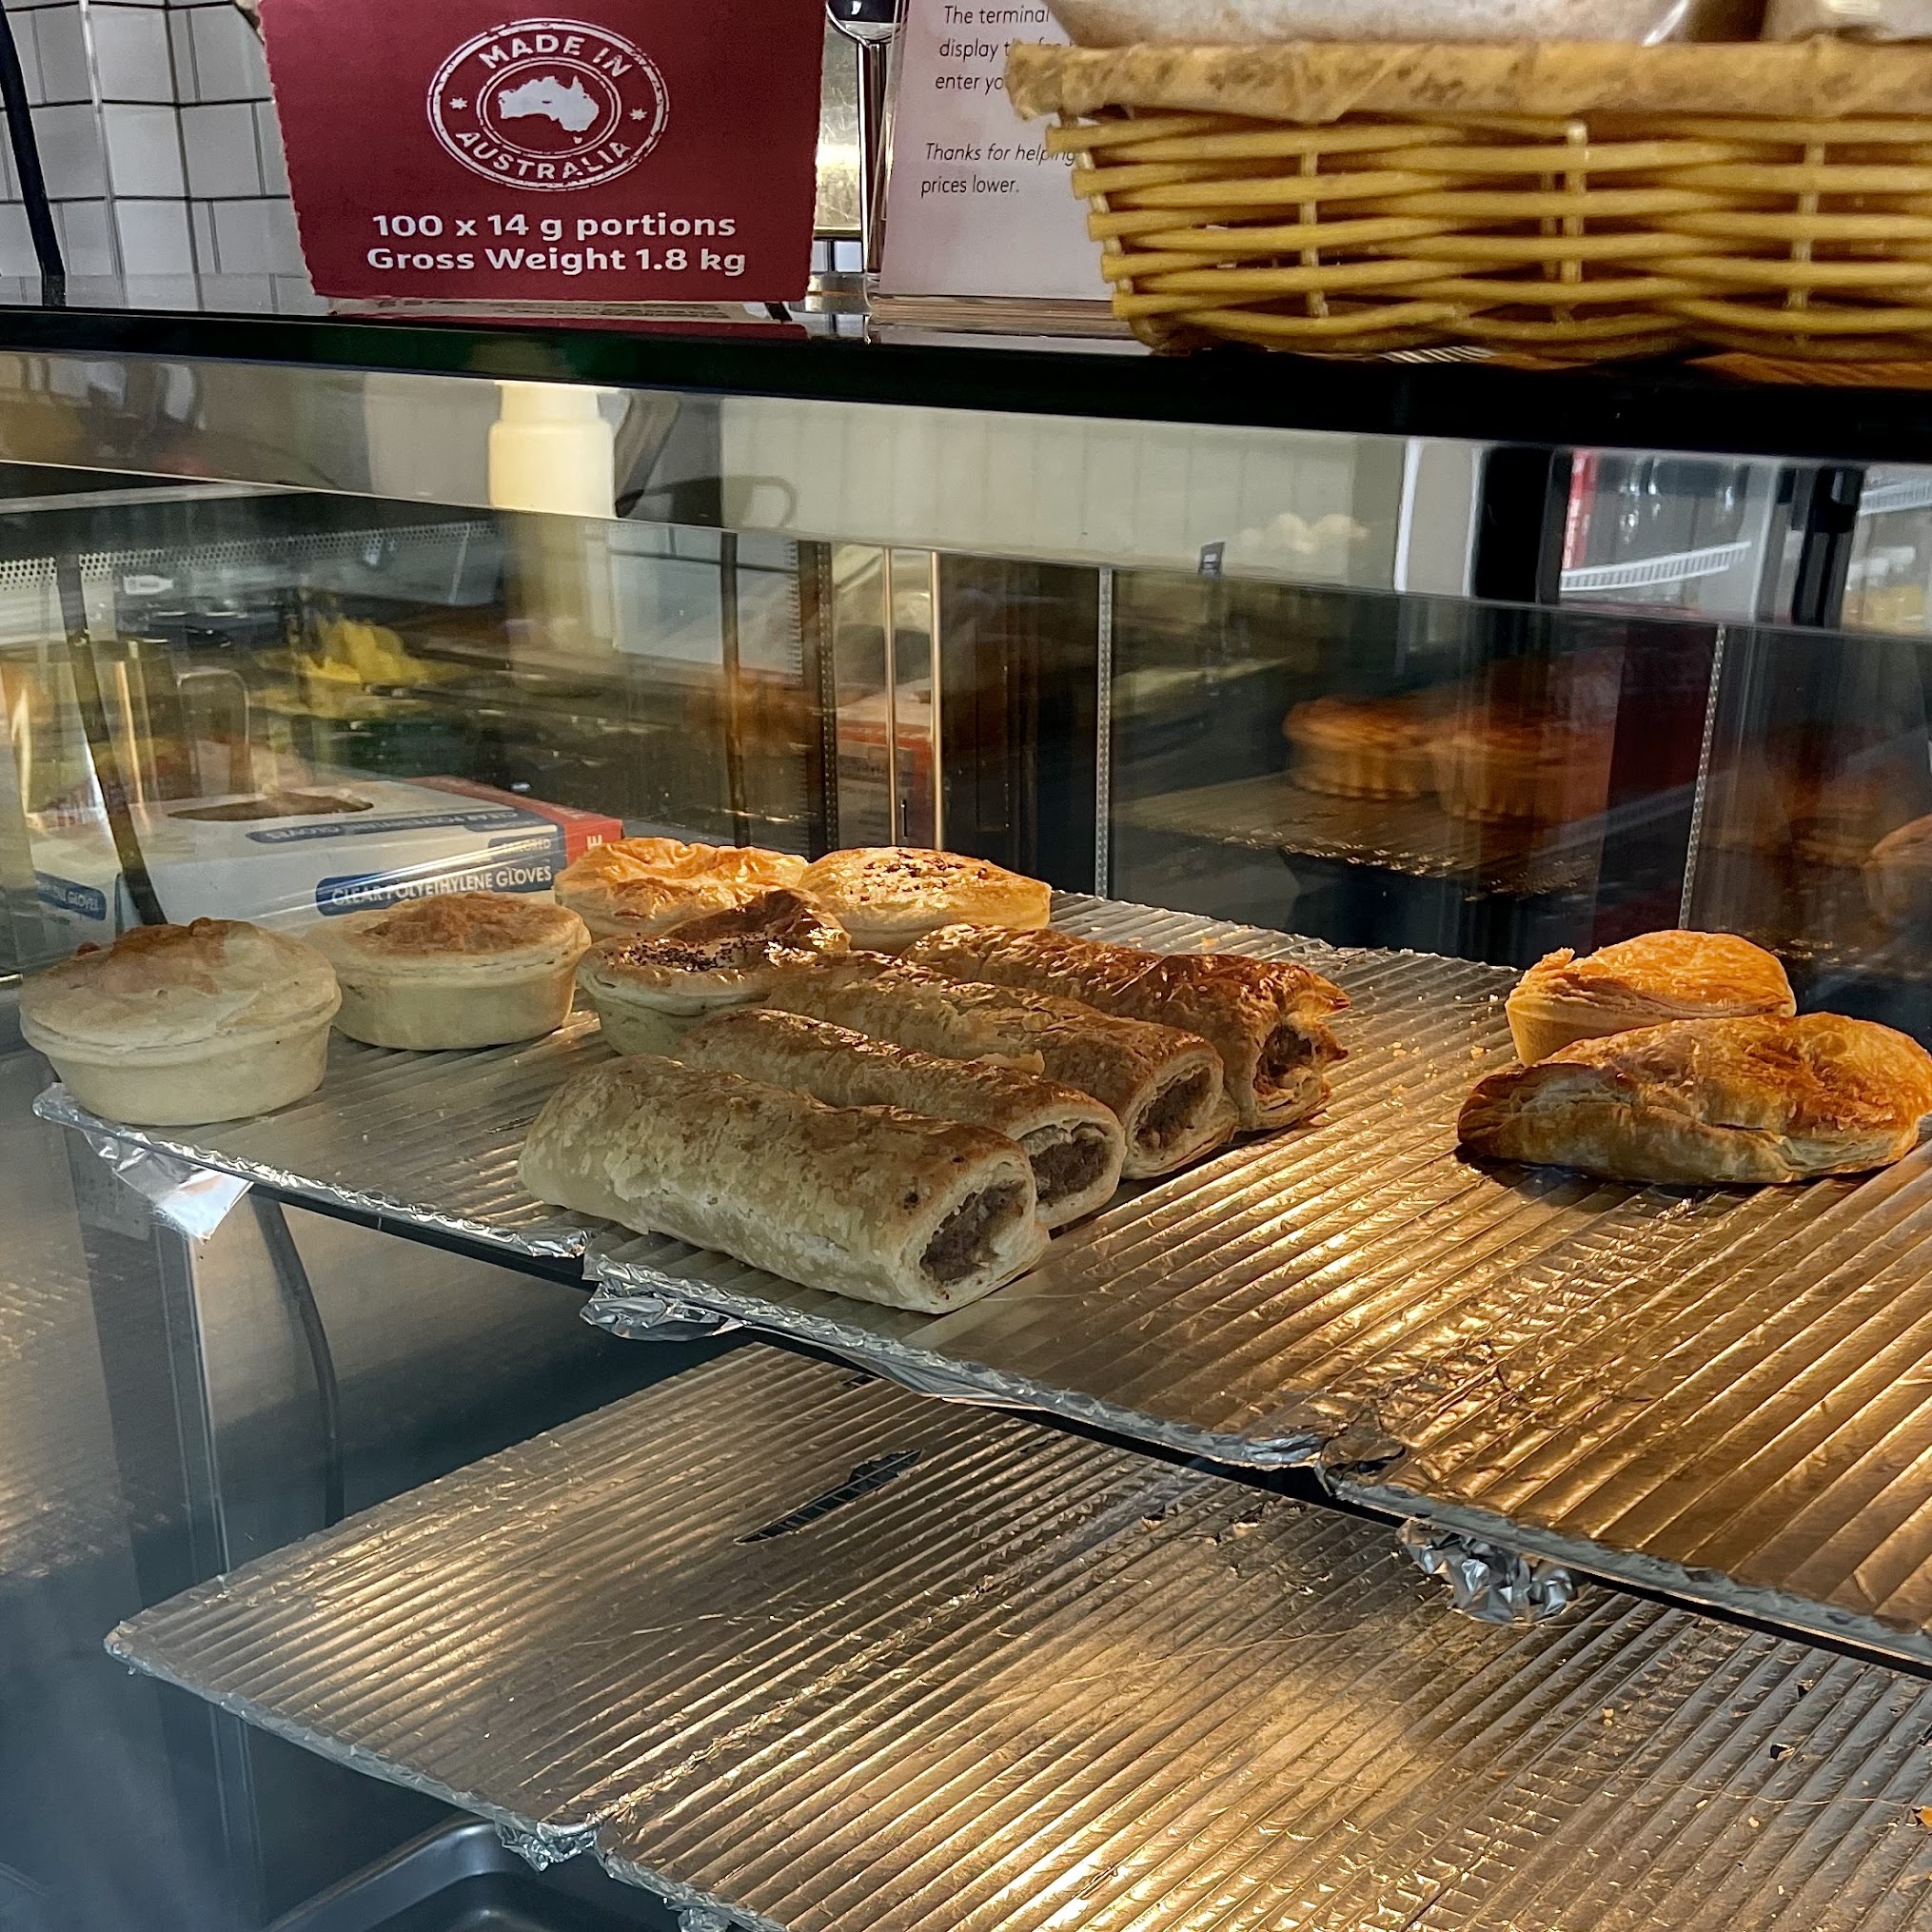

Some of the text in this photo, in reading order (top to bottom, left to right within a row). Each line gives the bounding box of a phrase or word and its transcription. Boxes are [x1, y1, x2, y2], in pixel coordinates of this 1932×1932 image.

[944, 6, 1050, 24] The terminal
[479, 34, 633, 77] MADE IN
[939, 38, 999, 63] display
[936, 75, 979, 90] enter
[455, 131, 631, 180] AUSTRALIA
[926, 143, 981, 161] Thanks
[987, 144, 1011, 161] for
[921, 175, 1019, 198] prices lower.
[372, 212, 736, 241] 100 x 14 g portions
[367, 246, 746, 276] Gross Weight 1.8 kg
[496, 865, 551, 887] GLOVES
